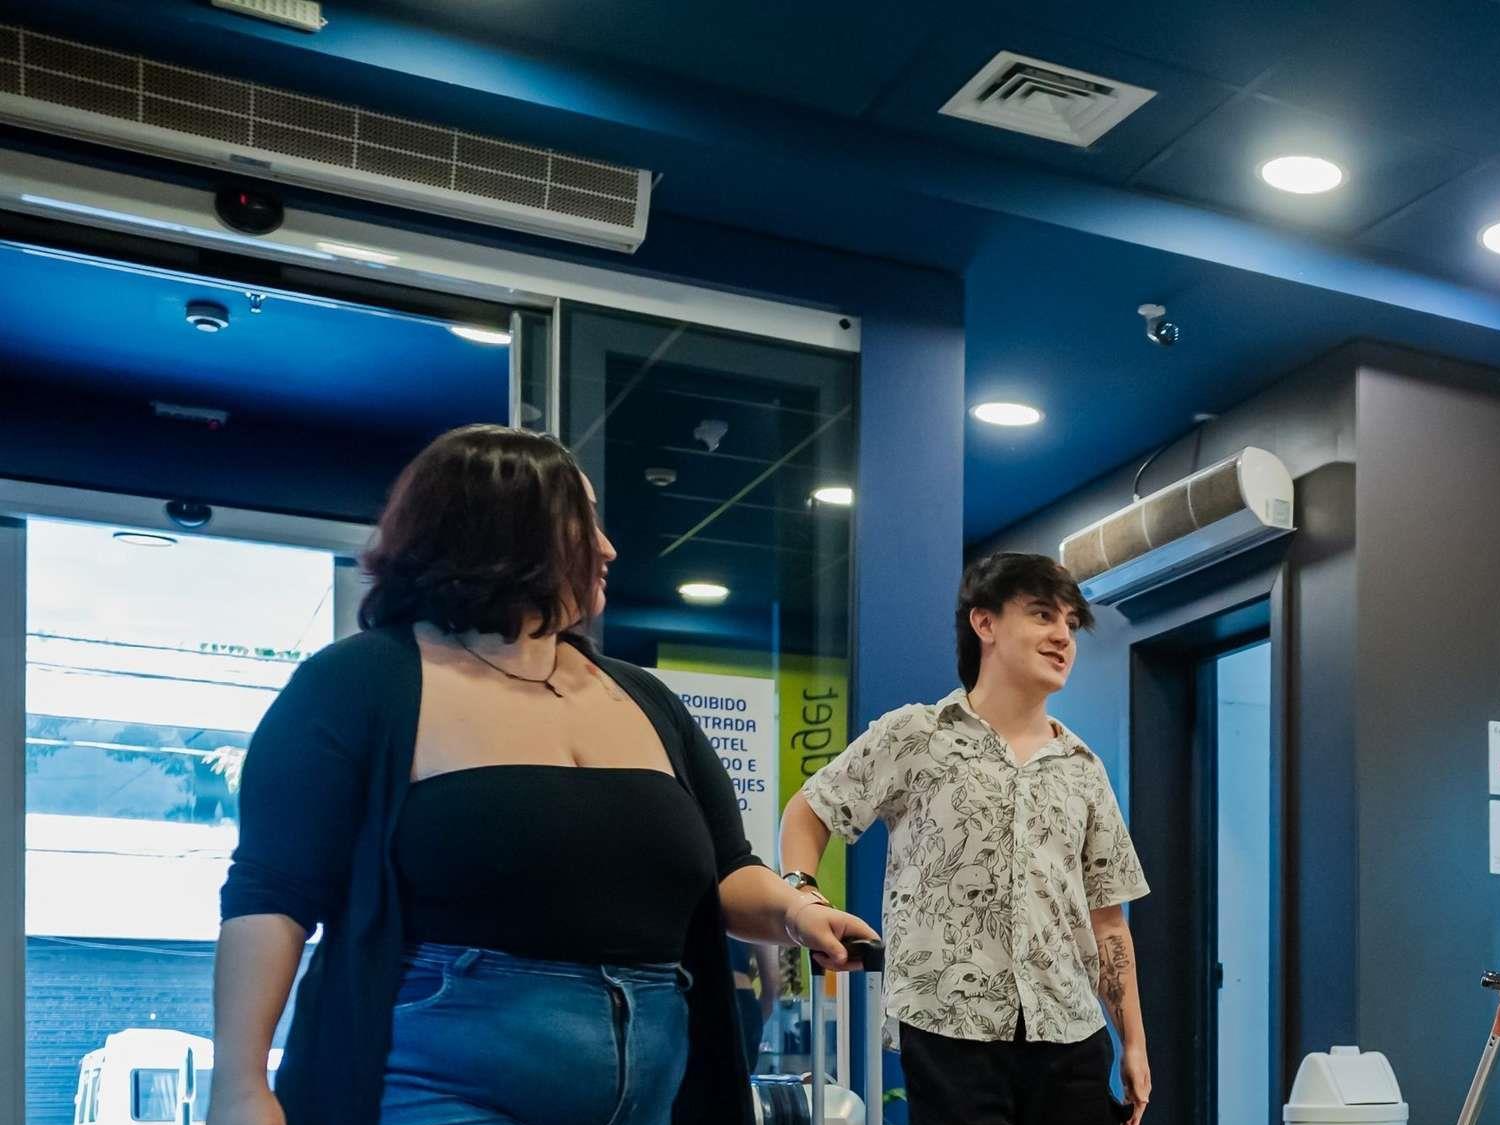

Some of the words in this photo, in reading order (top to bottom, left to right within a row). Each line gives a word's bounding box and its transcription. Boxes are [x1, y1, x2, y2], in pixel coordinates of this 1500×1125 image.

[680, 694, 747, 712] ROIBIDO
[692, 714, 757, 733] TRADA
[710, 736, 748, 752] OTEL
[748, 759, 757, 772] E
[732, 777, 765, 794] AJES
